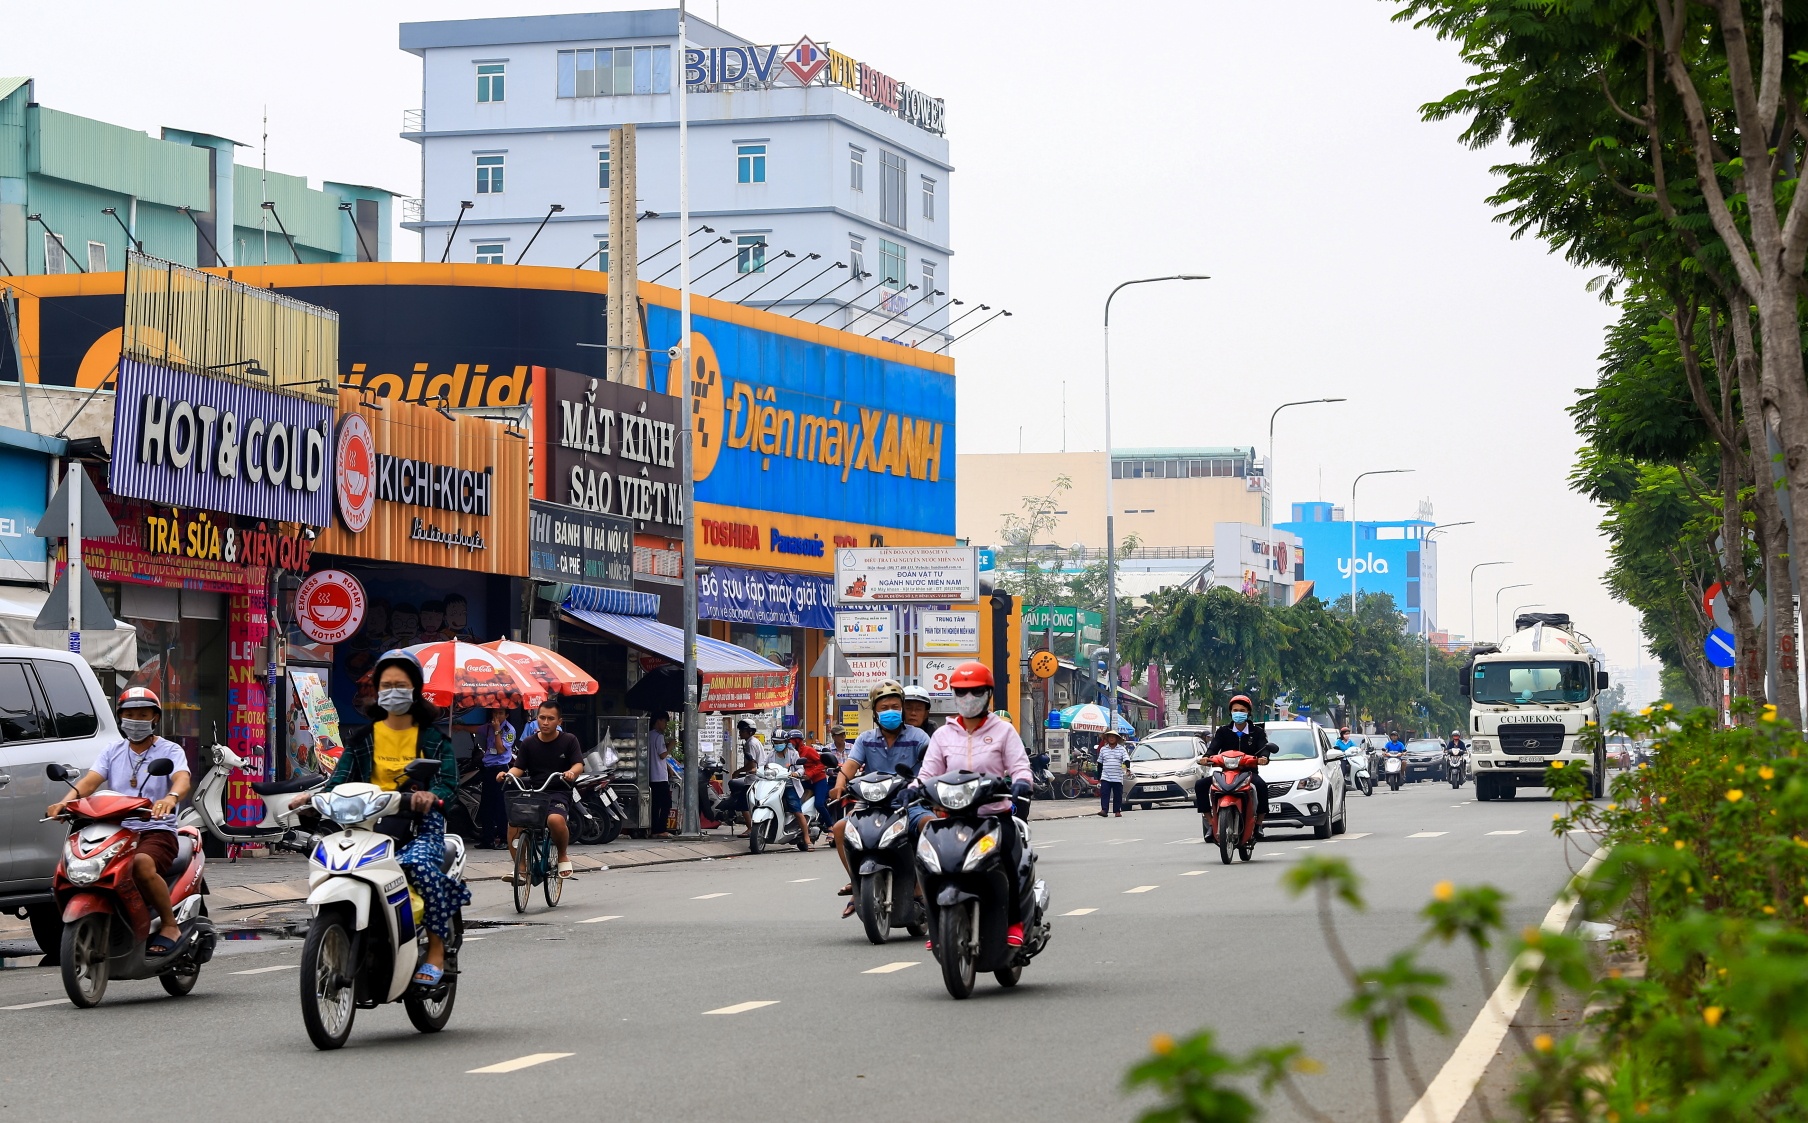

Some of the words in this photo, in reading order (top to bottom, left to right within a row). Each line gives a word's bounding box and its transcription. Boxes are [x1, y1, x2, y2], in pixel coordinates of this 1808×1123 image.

[684, 45, 779, 85] BIDV
[828, 48, 857, 90] WIN
[860, 62, 899, 110] HOME
[903, 84, 946, 134] TOWER
[561, 378, 615, 456] MẮT
[620, 401, 675, 468] KÍNH
[726, 381, 794, 471] Điện
[338, 427, 350, 476] EXPRESS
[364, 431, 375, 477] ROTARY
[379, 453, 491, 516] KICHI-KICHI
[569, 465, 612, 514] SAO
[617, 466, 665, 530] VIỆT
[667, 483, 684, 526] NA
[345, 508, 366, 525] HOTPOT
[148, 507, 180, 556] TRÀ
[187, 512, 220, 561] SỮA
[225, 527, 237, 562] &
[241, 521, 277, 567] XIÊN
[554, 516, 580, 547] BÁNH
[594, 523, 605, 551] HÀ
[607, 525, 621, 557] NỘI
[623, 532, 629, 553] 4
[702, 518, 760, 551] TOSHIBA
[770, 527, 824, 558] Panasonic
[560, 551, 568, 573] CÀ
[569, 554, 580, 575] PHÊ
[918, 571, 932, 579] VẬT
[1338, 552, 1388, 579] yola
[299, 578, 318, 611] EXPRESS
[343, 578, 361, 608] ROTARY
[701, 572, 718, 601] Bộ
[722, 578, 742, 600] sưu
[745, 576, 765, 606] tập
[769, 579, 792, 611] máy
[796, 582, 817, 611] giặt
[879, 578, 904, 586] NGÀNH
[866, 624, 884, 633] THƠ
[1041, 609, 1073, 627] PHÒNG
[311, 629, 347, 640] HOTPOT
[925, 660, 945, 669] Cafe
[933, 673, 950, 691] 3
[1073, 723, 1105, 732] LIPOVITAN
[1500, 714, 1562, 724] CC1-MEKONG
[384, 875, 405, 893] YAMAHA
